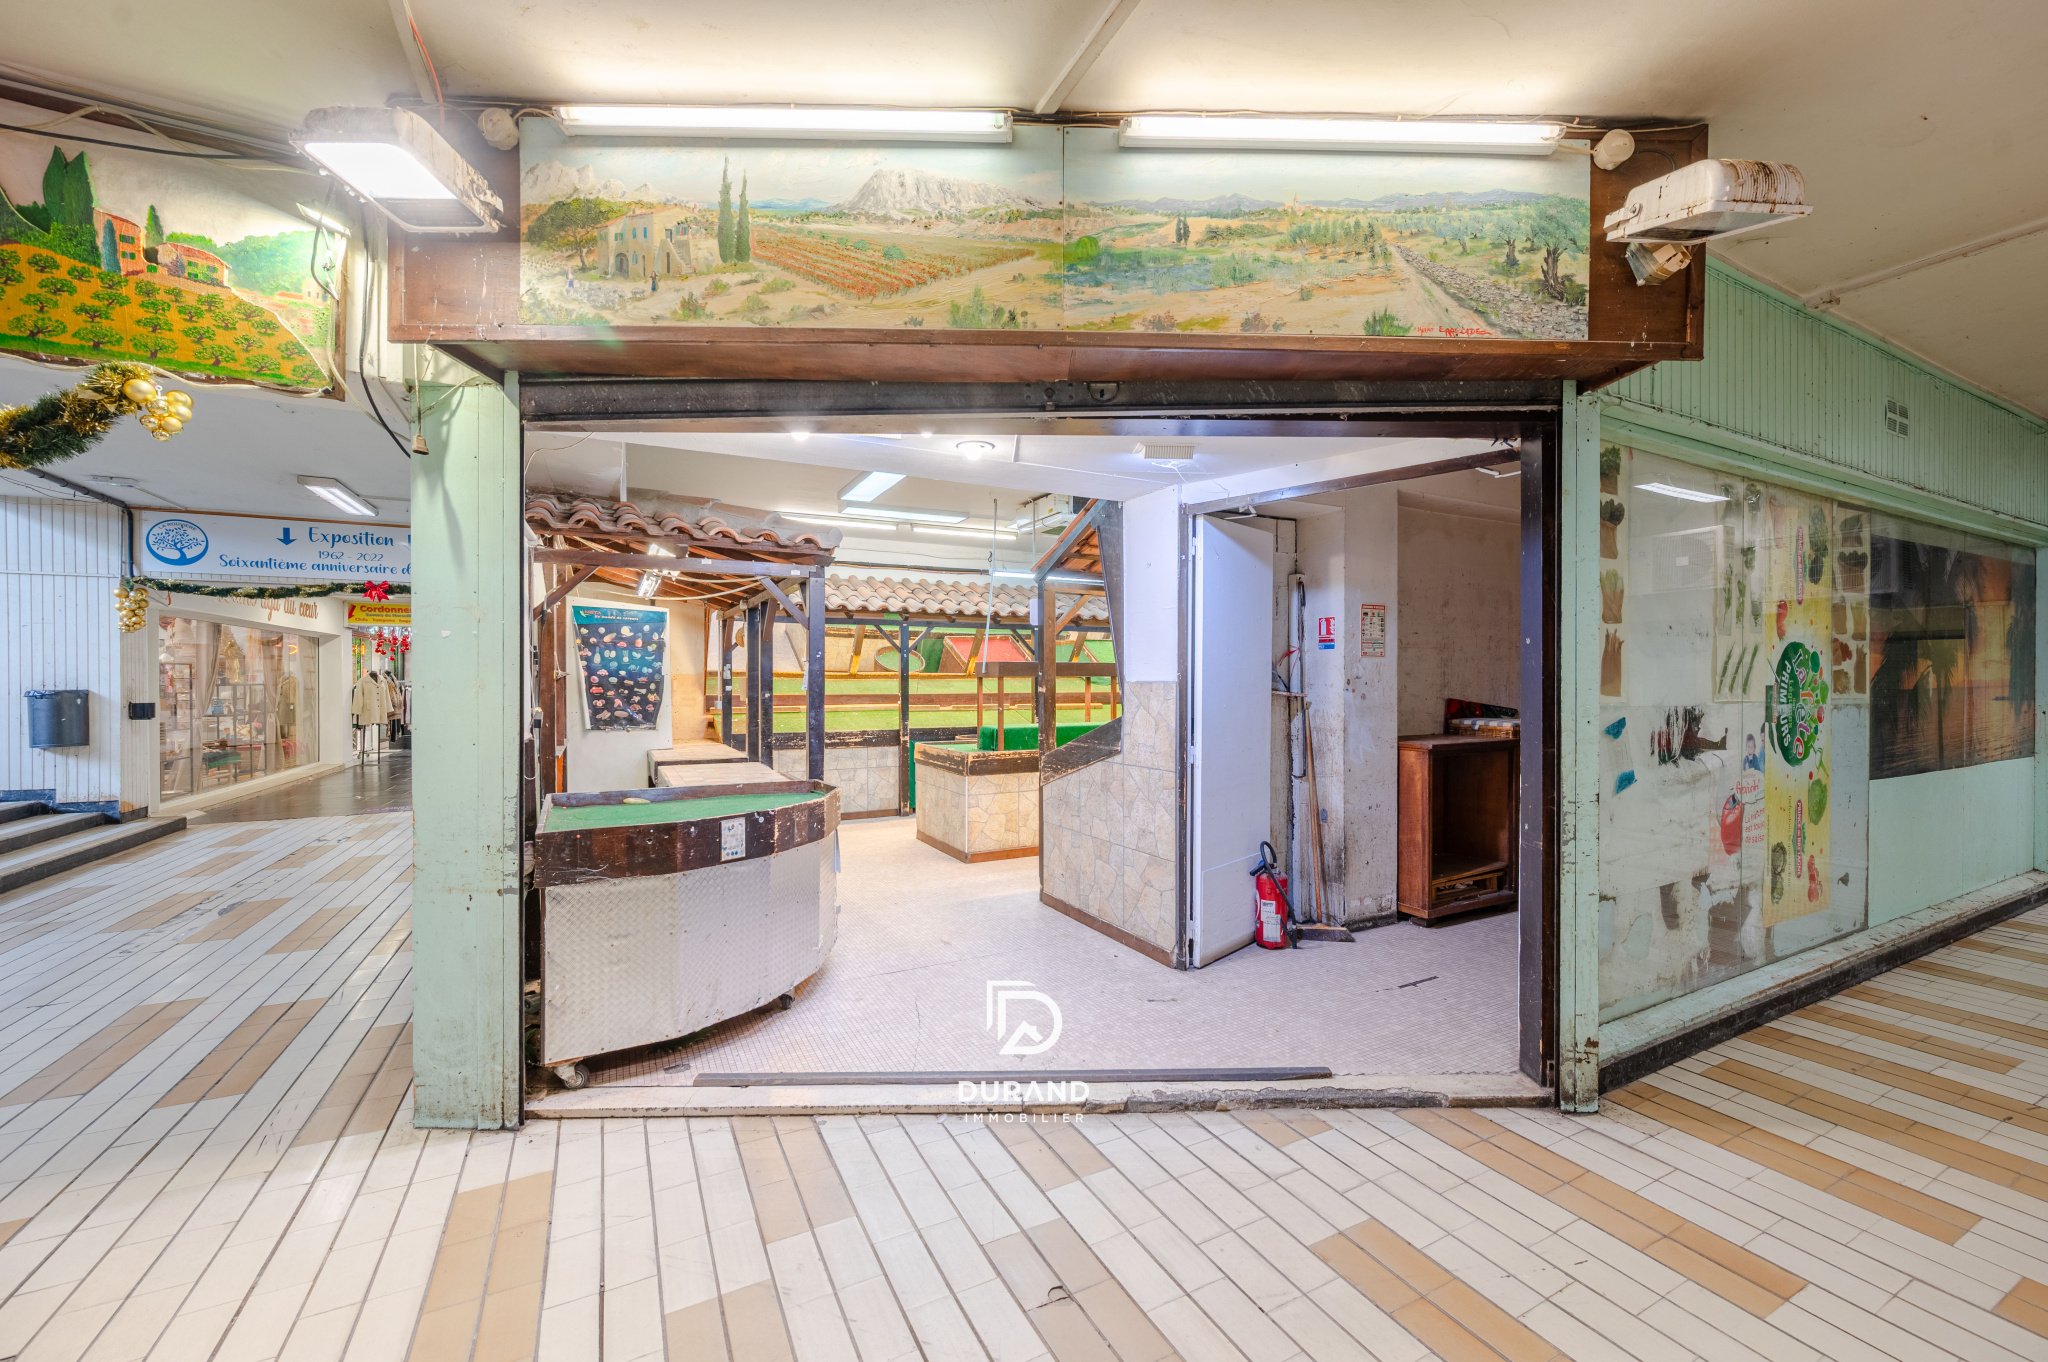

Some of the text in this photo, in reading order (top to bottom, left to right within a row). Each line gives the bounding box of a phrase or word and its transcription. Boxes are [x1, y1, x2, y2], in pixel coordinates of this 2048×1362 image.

[308, 526, 395, 548] Exposition
[219, 553, 308, 571] Soixantième
[311, 561, 398, 575] anniversaire
[318, 550, 345, 560] 1962
[356, 552, 384, 562] 2022
[1780, 661, 1791, 746] PRIMEURS
[1792, 649, 1814, 758] La fête
